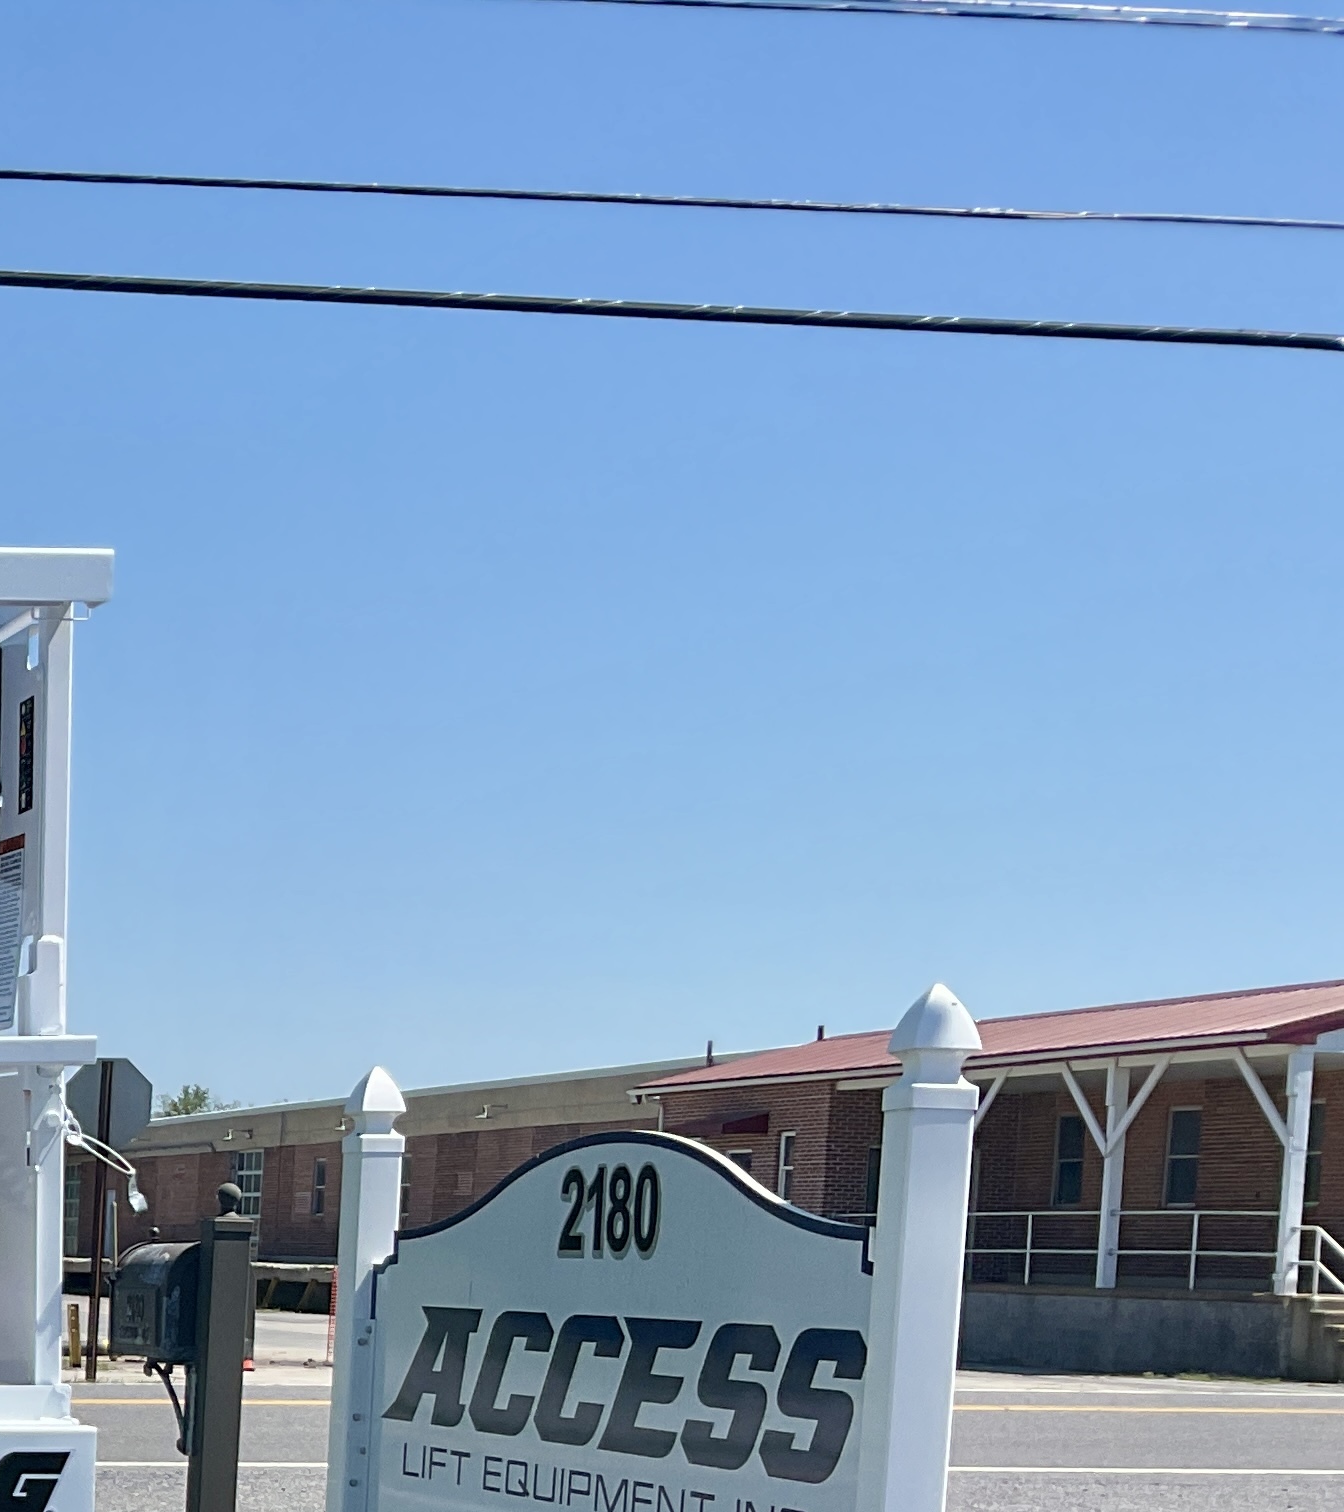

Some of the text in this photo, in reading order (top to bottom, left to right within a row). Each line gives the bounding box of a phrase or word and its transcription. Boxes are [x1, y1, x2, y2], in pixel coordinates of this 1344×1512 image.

[557, 1162, 662, 1260] 2180
[382, 1306, 868, 1484] ACCESS
[402, 1442, 471, 1487] LIFT
